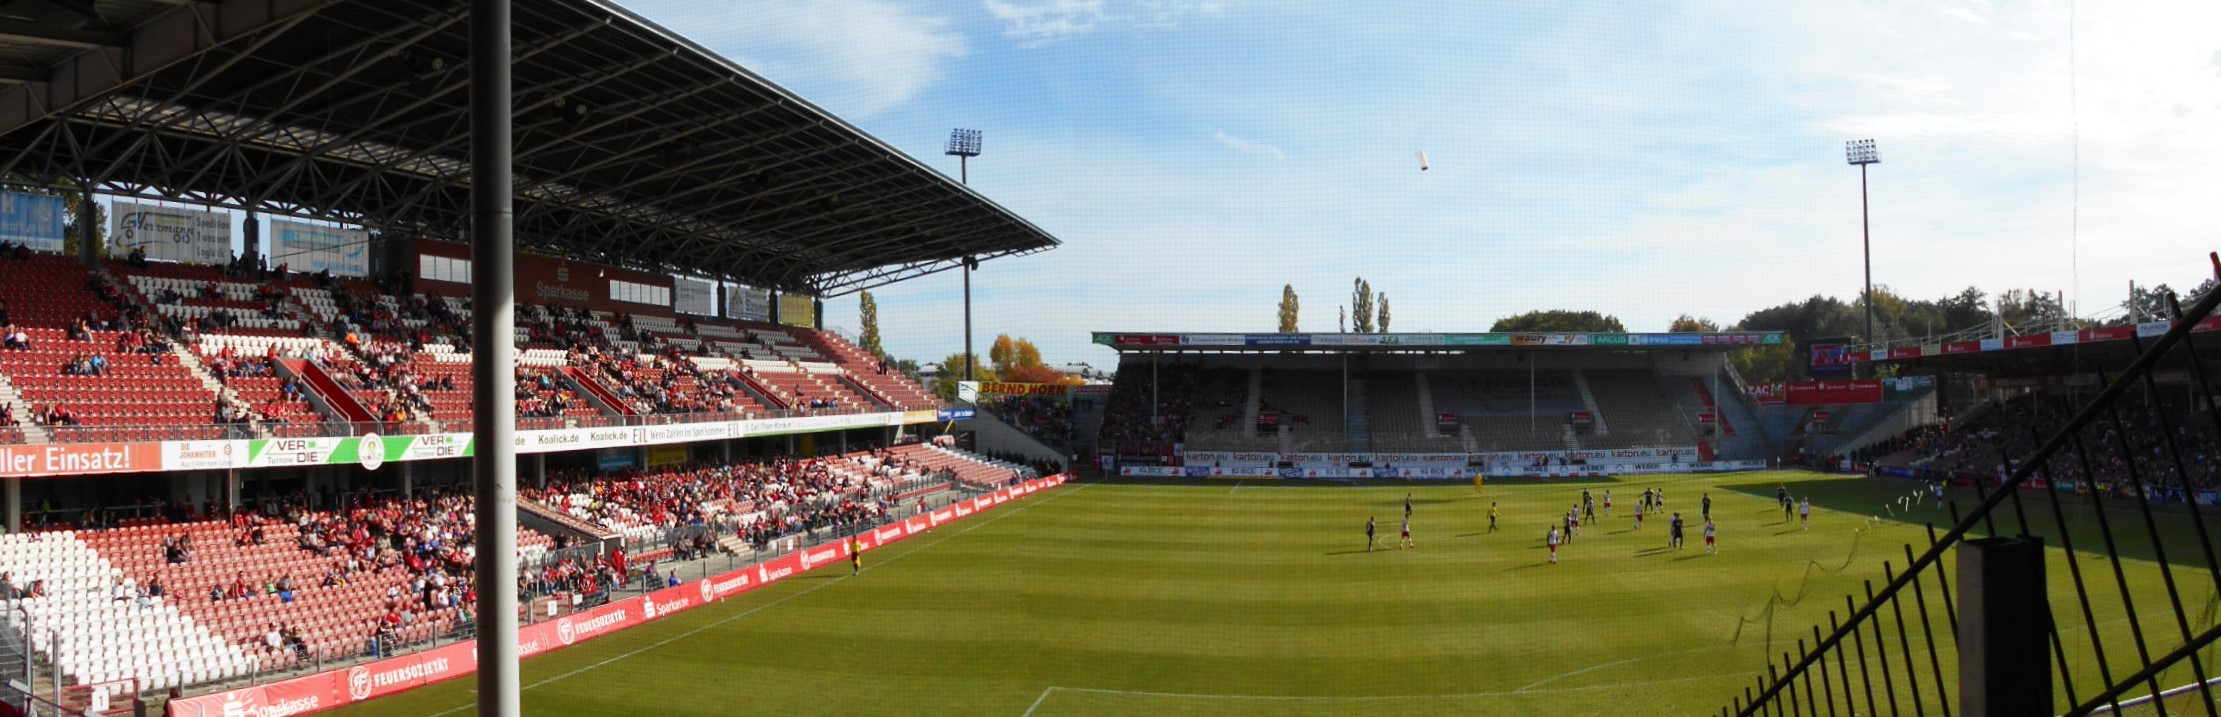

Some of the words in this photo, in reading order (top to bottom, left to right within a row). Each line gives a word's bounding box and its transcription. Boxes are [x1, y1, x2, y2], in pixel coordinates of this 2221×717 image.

[536, 281, 589, 301] Sparkasse
[982, 382, 1025, 395] BERND
[1028, 384, 1066, 396] HORN
[632, 428, 648, 443] ETL
[727, 423, 740, 437] ETL
[422, 435, 444, 446] VER
[538, 434, 579, 445] Koalick.de
[590, 431, 628, 442] Koalick.de
[277, 439, 306, 451] VER
[437, 445, 454, 456] DIE
[297, 451, 318, 463] DIE
[1233, 453, 1275, 461] karton.eu
[1327, 453, 1370, 462] karton.eu
[1375, 453, 1418, 462] karton.eu
[1611, 449, 1651, 457] karton.eu
[1656, 448, 1695, 456] karton.eu
[0, 448, 36, 473] ller
[46, 445, 129, 471] Einsatz!
[656, 597, 689, 616] Sparkasse
[575, 608, 626, 635] FEUERSOZIETÄT
[374, 657, 449, 687] FEUERSOZIETÄT
[98, 695, 104, 707] 1
